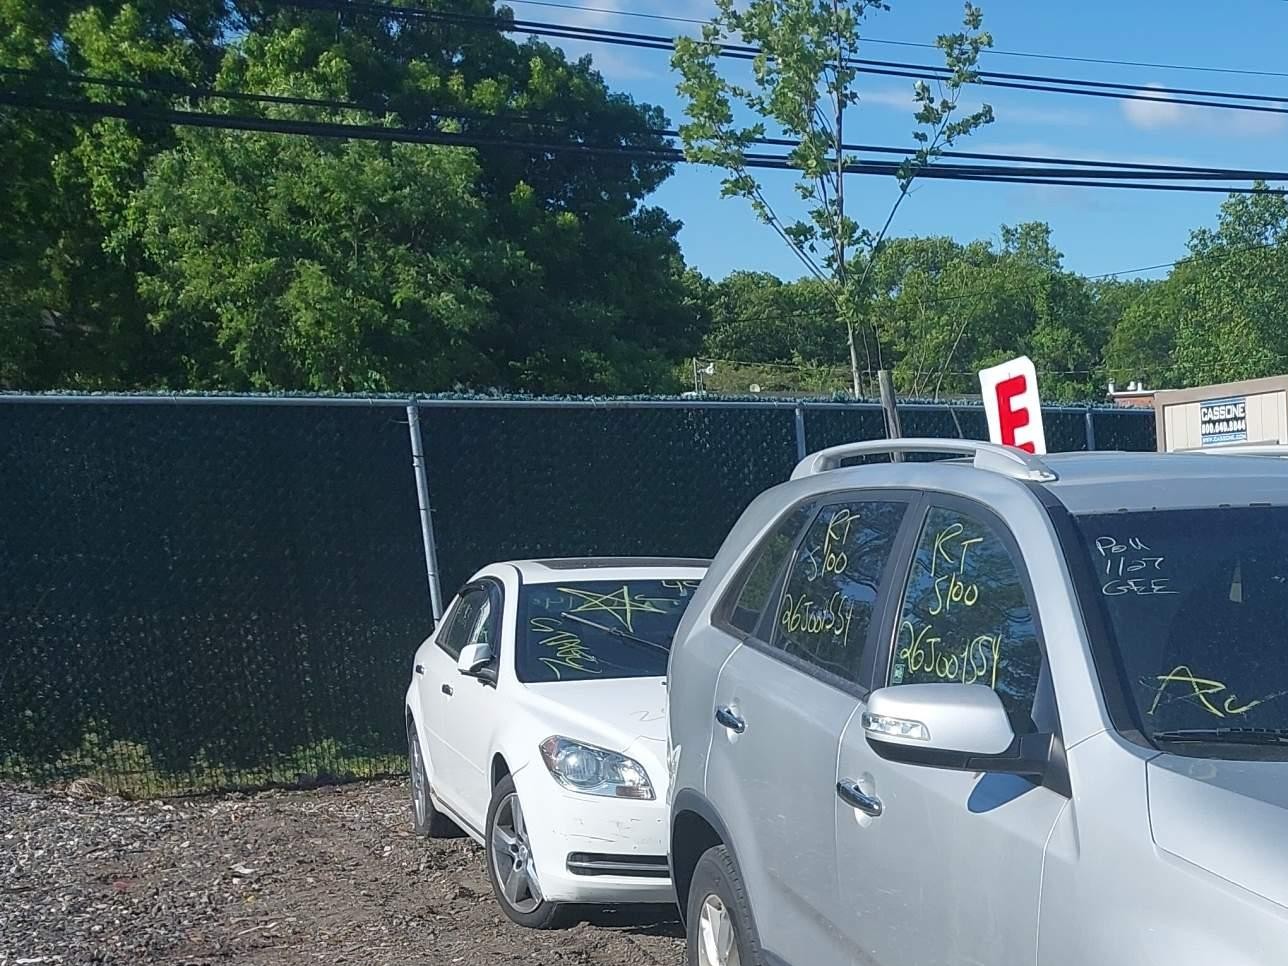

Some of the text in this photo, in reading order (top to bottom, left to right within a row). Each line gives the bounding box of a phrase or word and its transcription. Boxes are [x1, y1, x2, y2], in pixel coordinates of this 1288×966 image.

[1201, 403, 1246, 421] CASSONE
[824, 508, 861, 555] RT
[930, 523, 984, 577] RT
